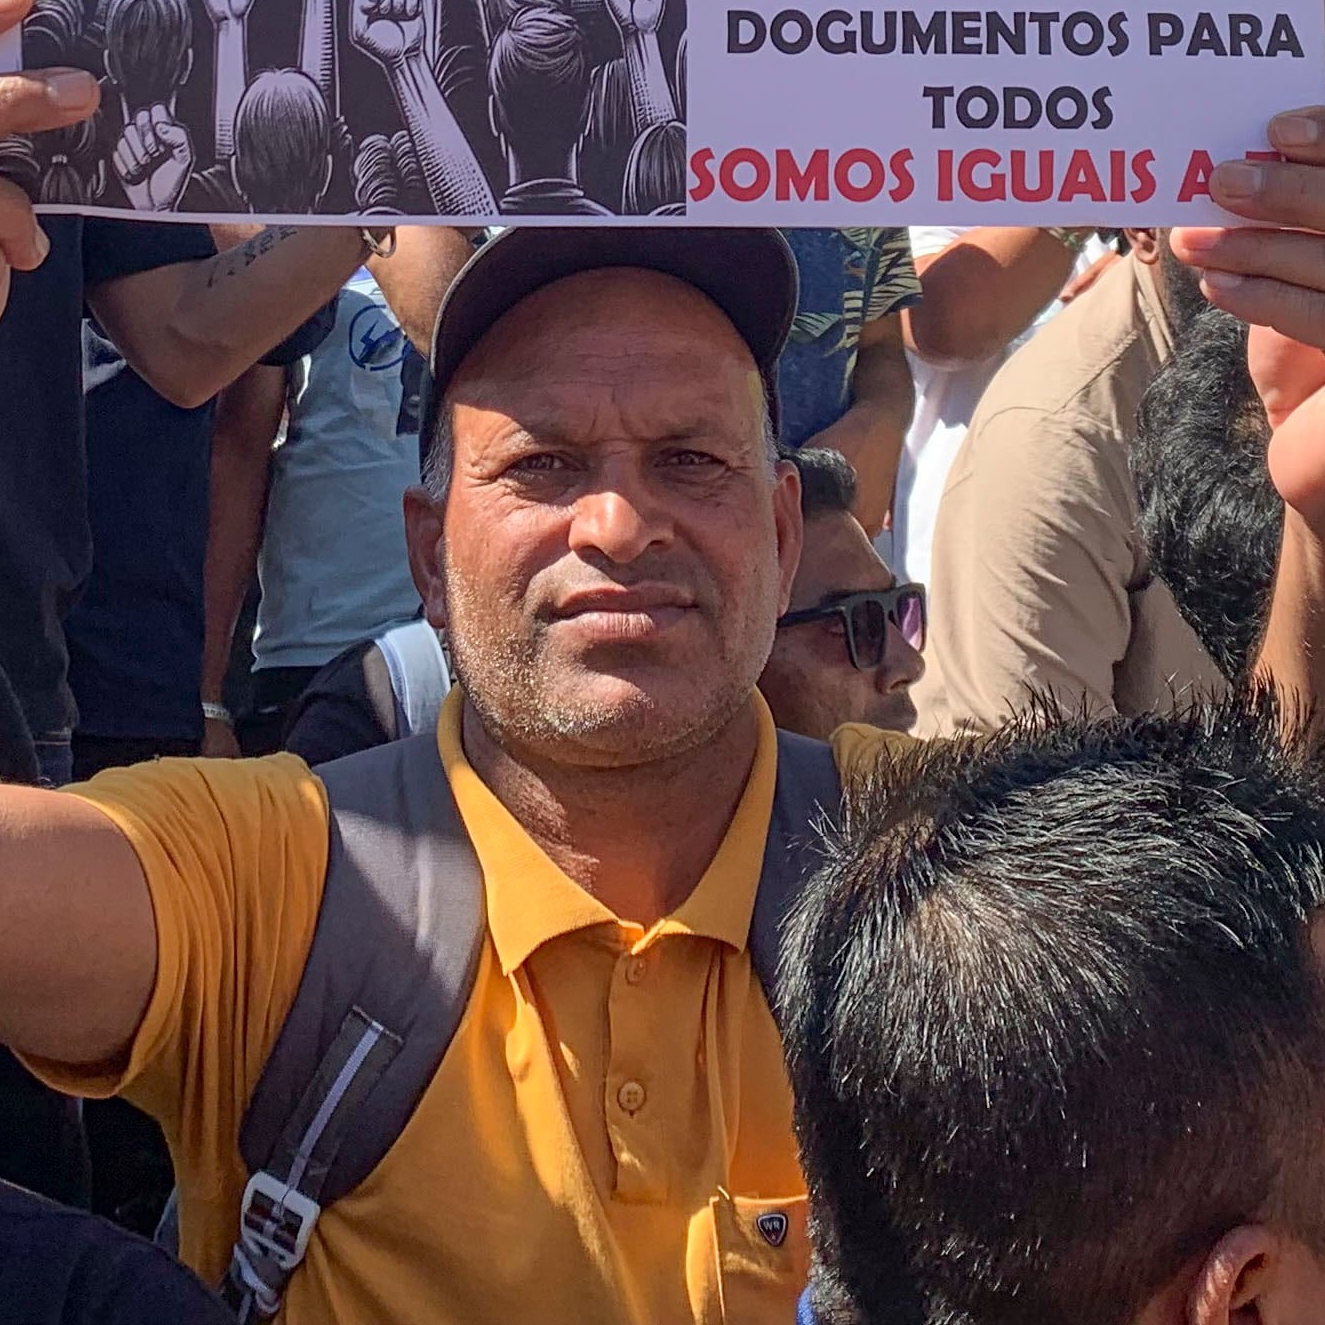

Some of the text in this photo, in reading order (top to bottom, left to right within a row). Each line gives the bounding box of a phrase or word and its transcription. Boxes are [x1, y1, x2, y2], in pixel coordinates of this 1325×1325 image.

[727, 8, 1305, 59] DOGUMENTOS PARA
[922, 85, 1114, 130] TODOS
[689, 147, 915, 203] SOMOS
[937, 148, 1157, 204] IGUAIS
